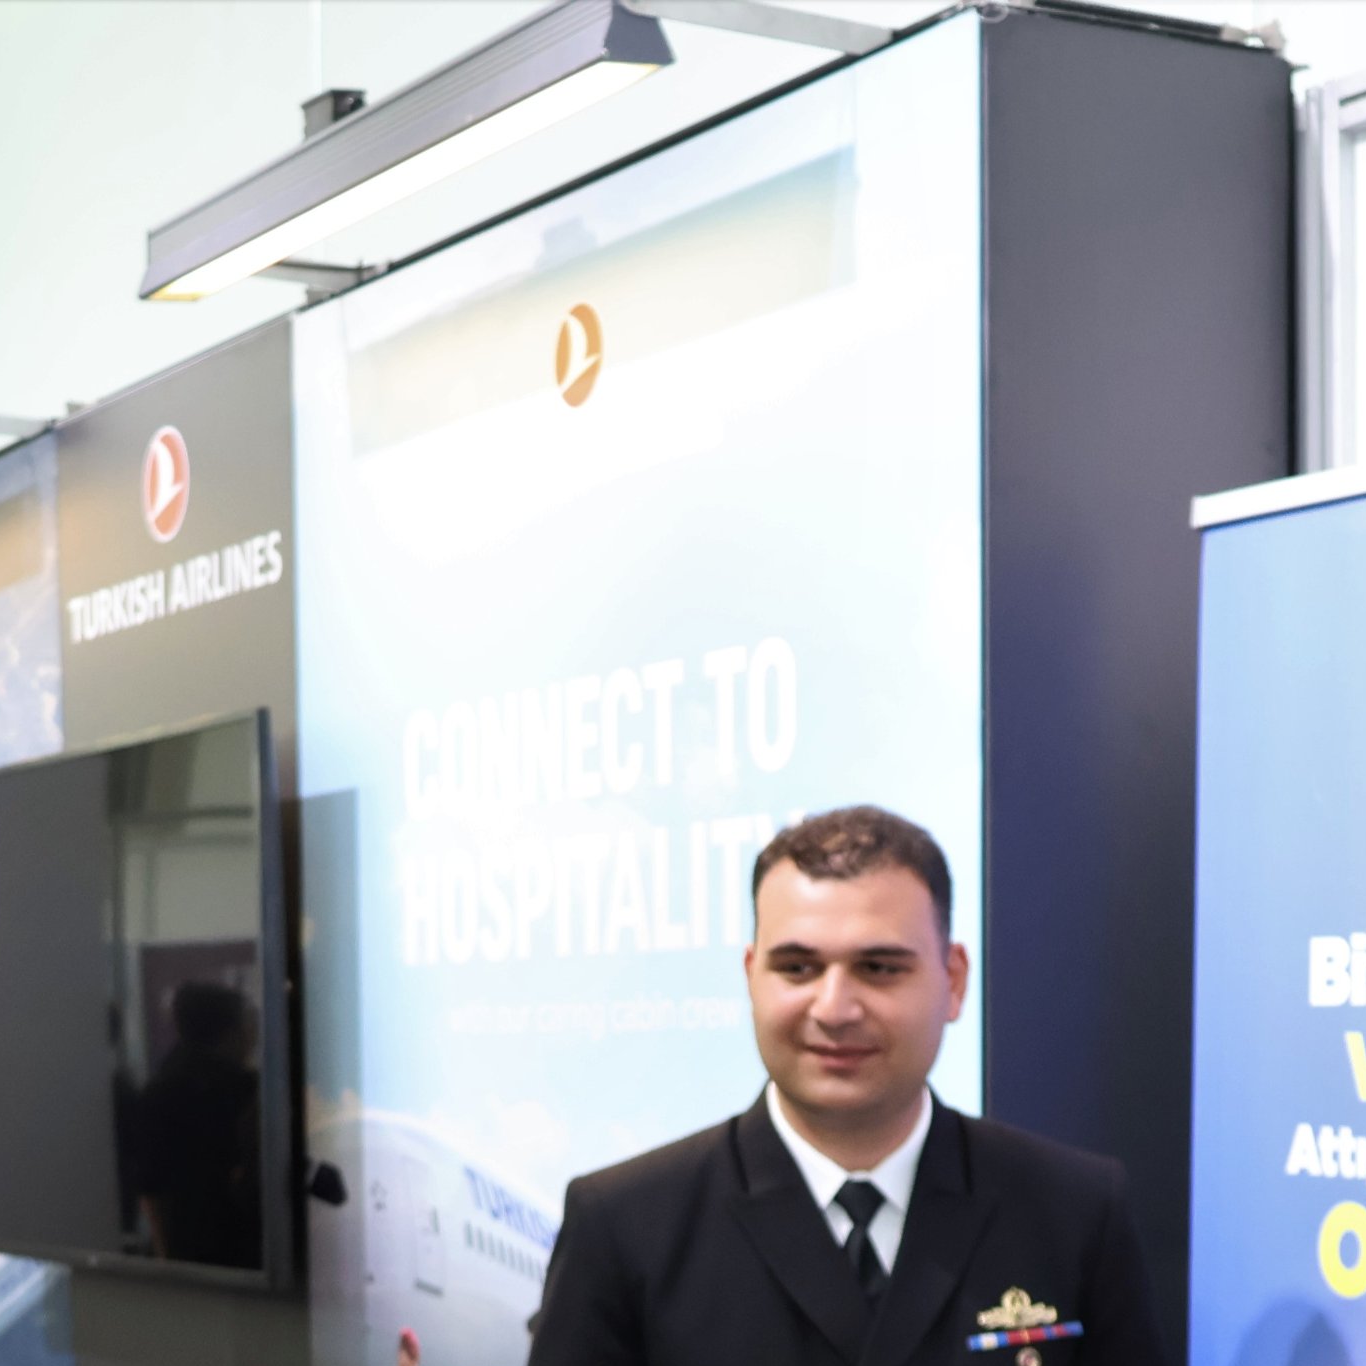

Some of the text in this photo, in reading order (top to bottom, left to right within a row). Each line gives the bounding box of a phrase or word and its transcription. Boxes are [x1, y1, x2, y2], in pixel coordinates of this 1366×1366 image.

[67, 533, 282, 645] TURKISH AIRLINES
[403, 635, 797, 819] CONNECT TO
